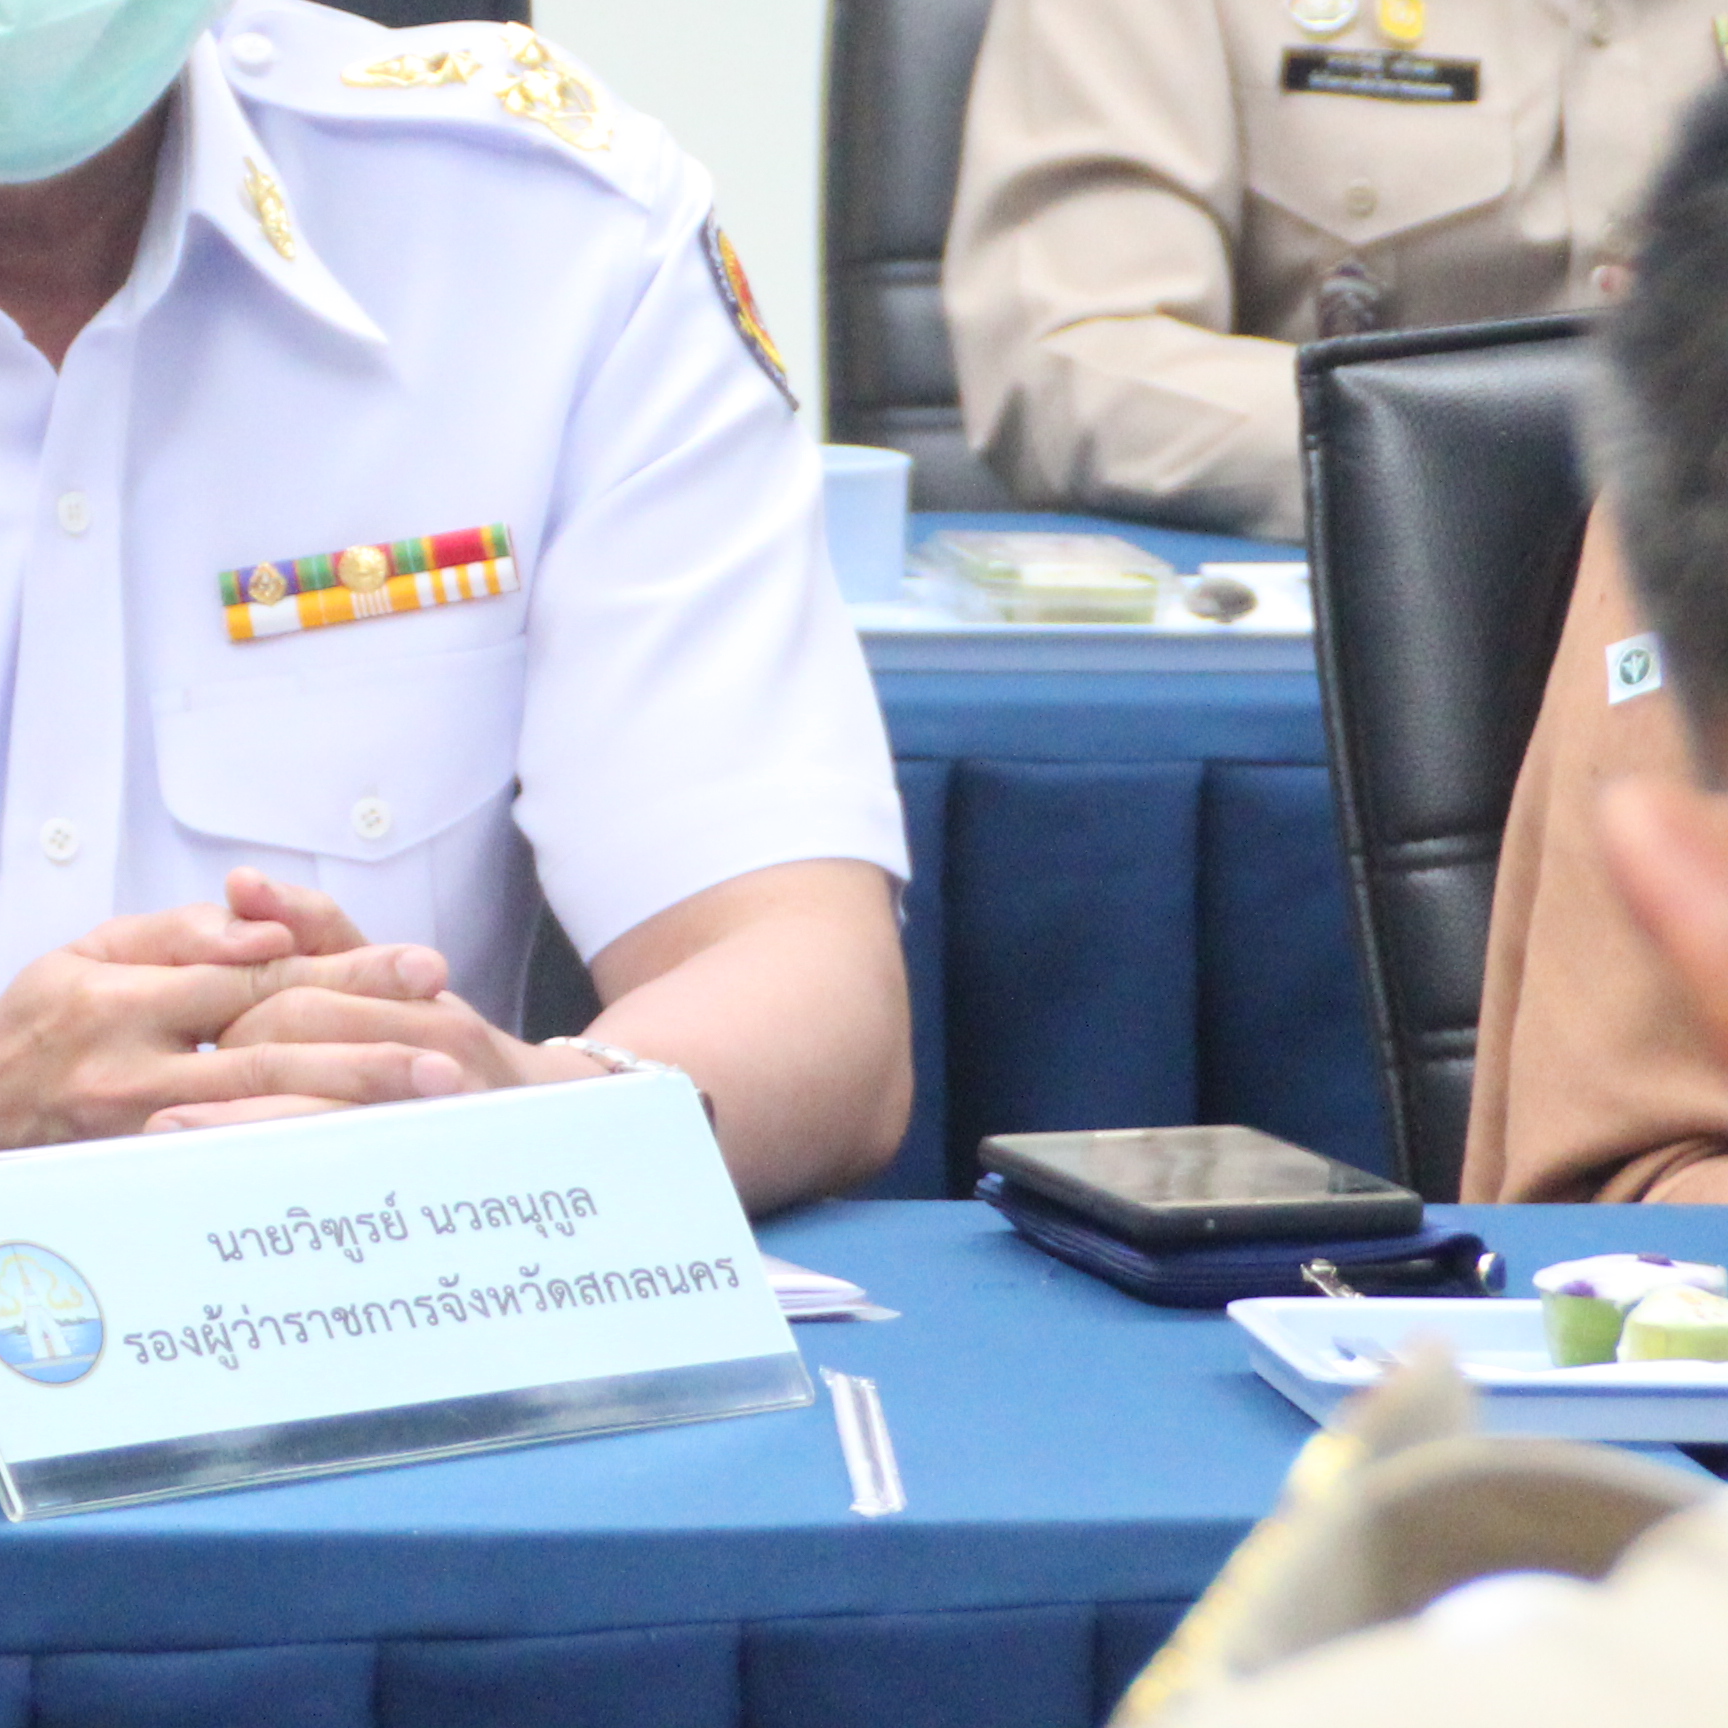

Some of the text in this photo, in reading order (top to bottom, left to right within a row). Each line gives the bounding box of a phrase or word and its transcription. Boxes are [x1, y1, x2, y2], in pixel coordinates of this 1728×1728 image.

[207, 1184, 599, 1263] นายวิฑูรย์ นวลนุกูล
[122, 1256, 740, 1370] รองผู้ว่าราชการจังหวัดสกลนคร
